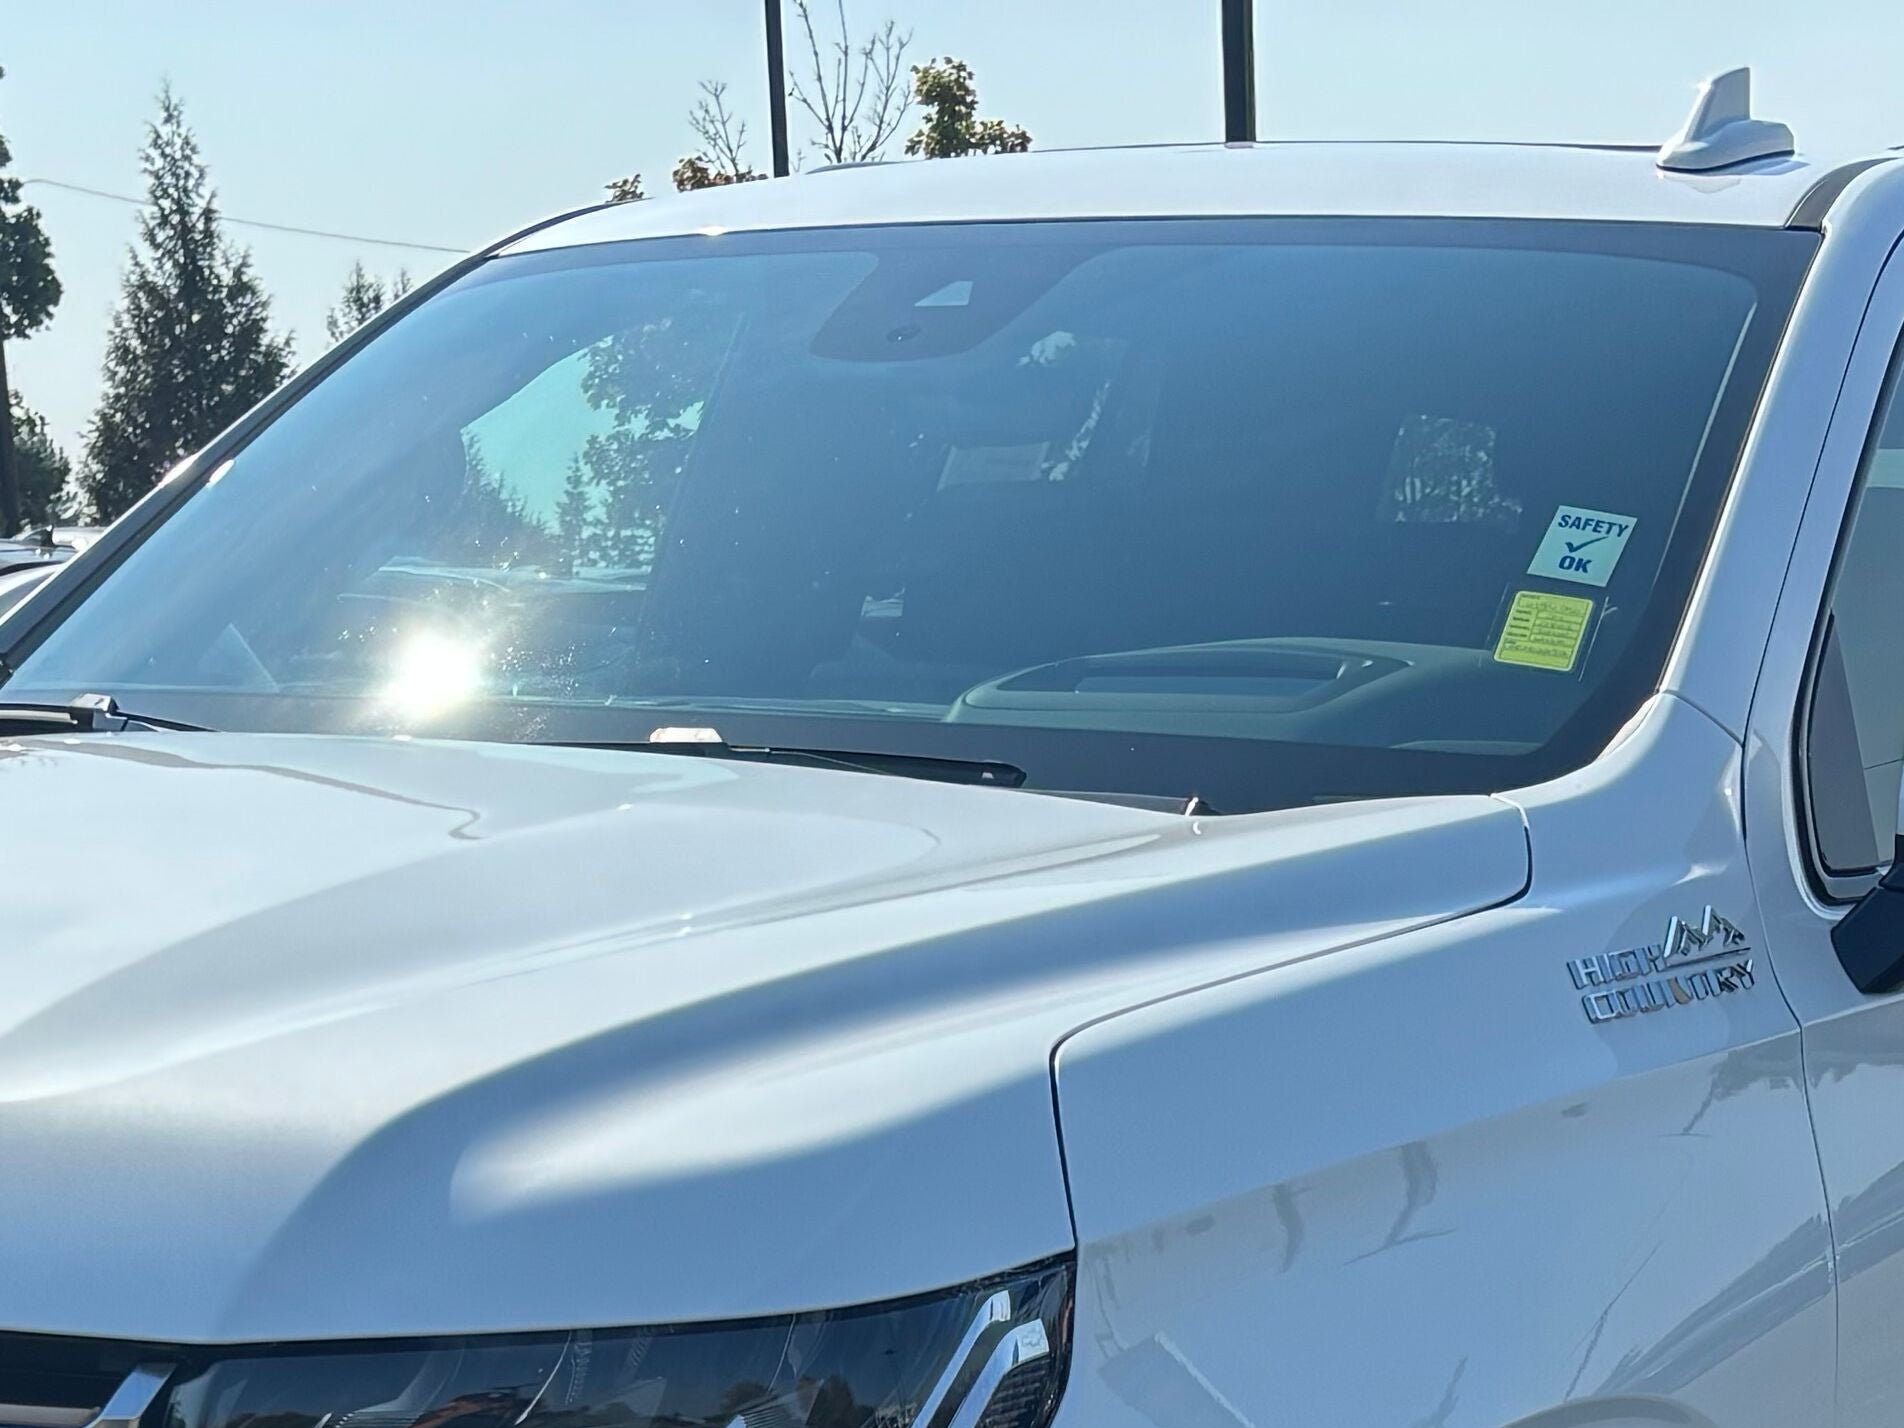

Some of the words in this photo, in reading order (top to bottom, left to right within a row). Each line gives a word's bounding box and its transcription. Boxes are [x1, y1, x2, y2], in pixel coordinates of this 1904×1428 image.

[1558, 514, 1628, 538] SAFETY
[1558, 555, 1592, 573] OK
[1567, 944, 1666, 990] HIGH
[1581, 959, 1755, 1024] COUNTRY
